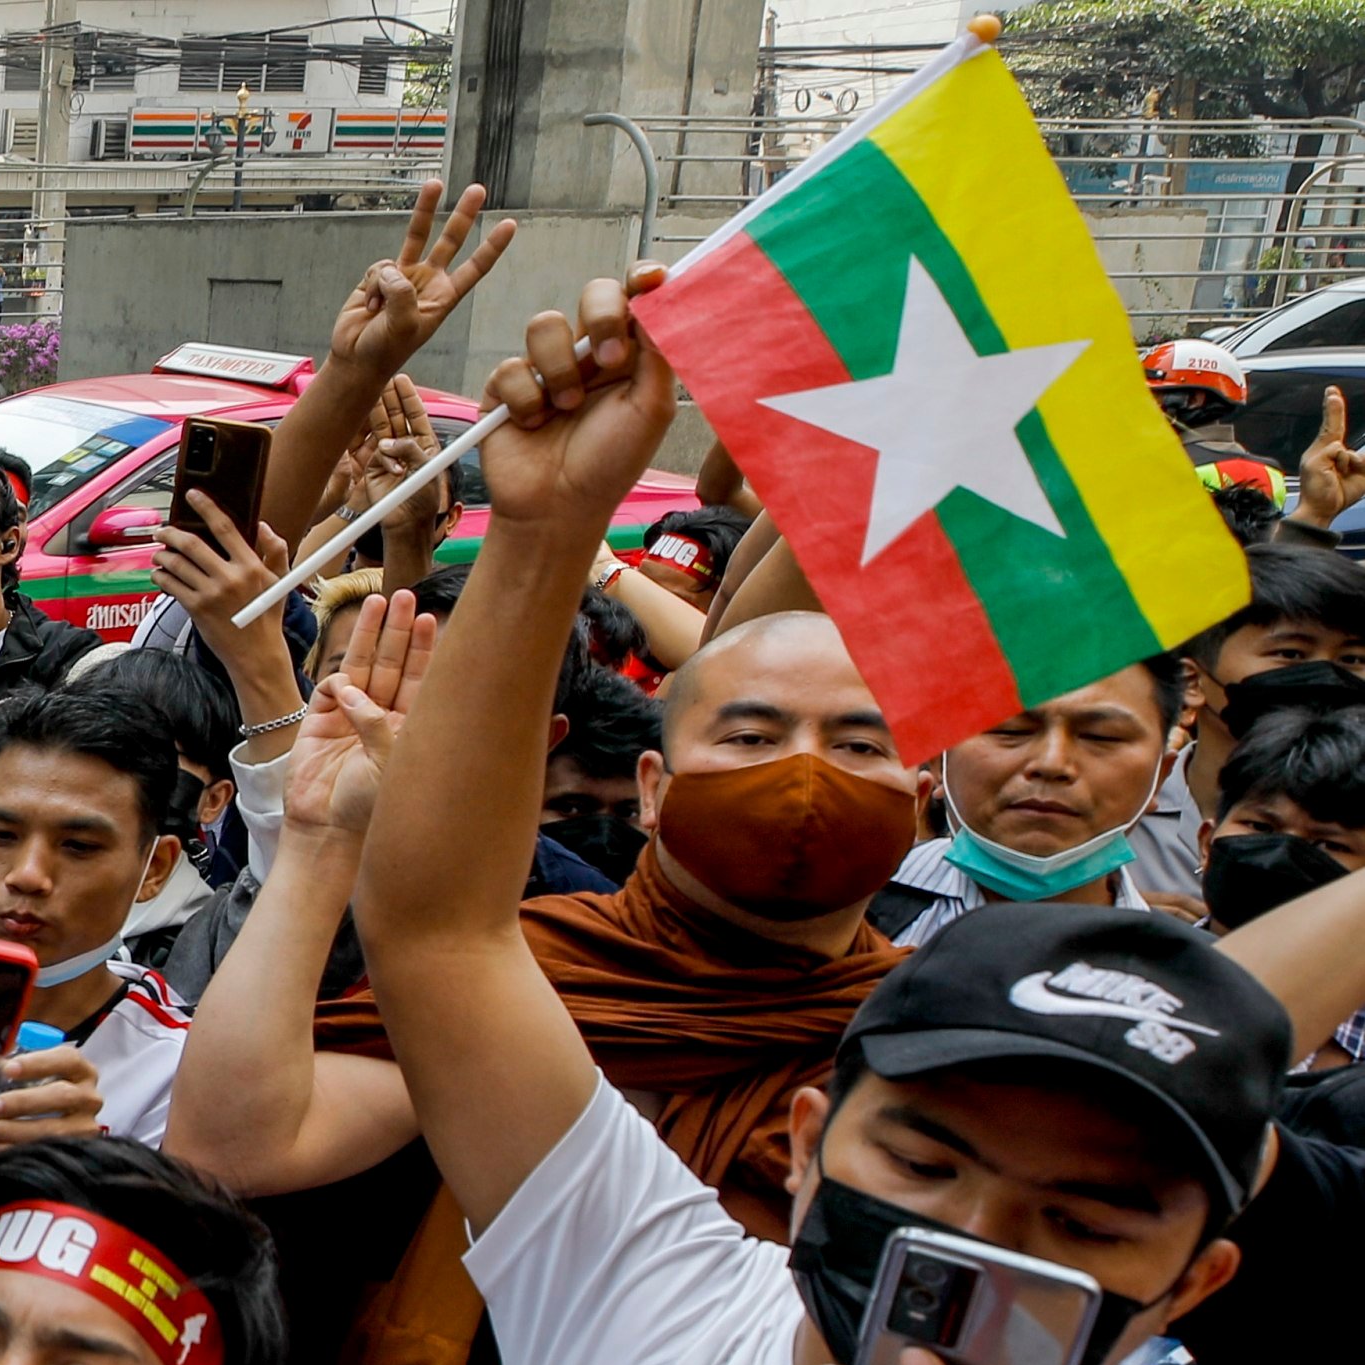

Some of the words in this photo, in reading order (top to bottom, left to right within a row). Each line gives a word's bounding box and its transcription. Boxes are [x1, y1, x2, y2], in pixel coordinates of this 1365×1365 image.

[1188, 358, 1218, 370] 2120
[648, 534, 699, 568] NUG
[1047, 961, 1185, 1015] NIKE
[1123, 1020, 1197, 1065] SB
